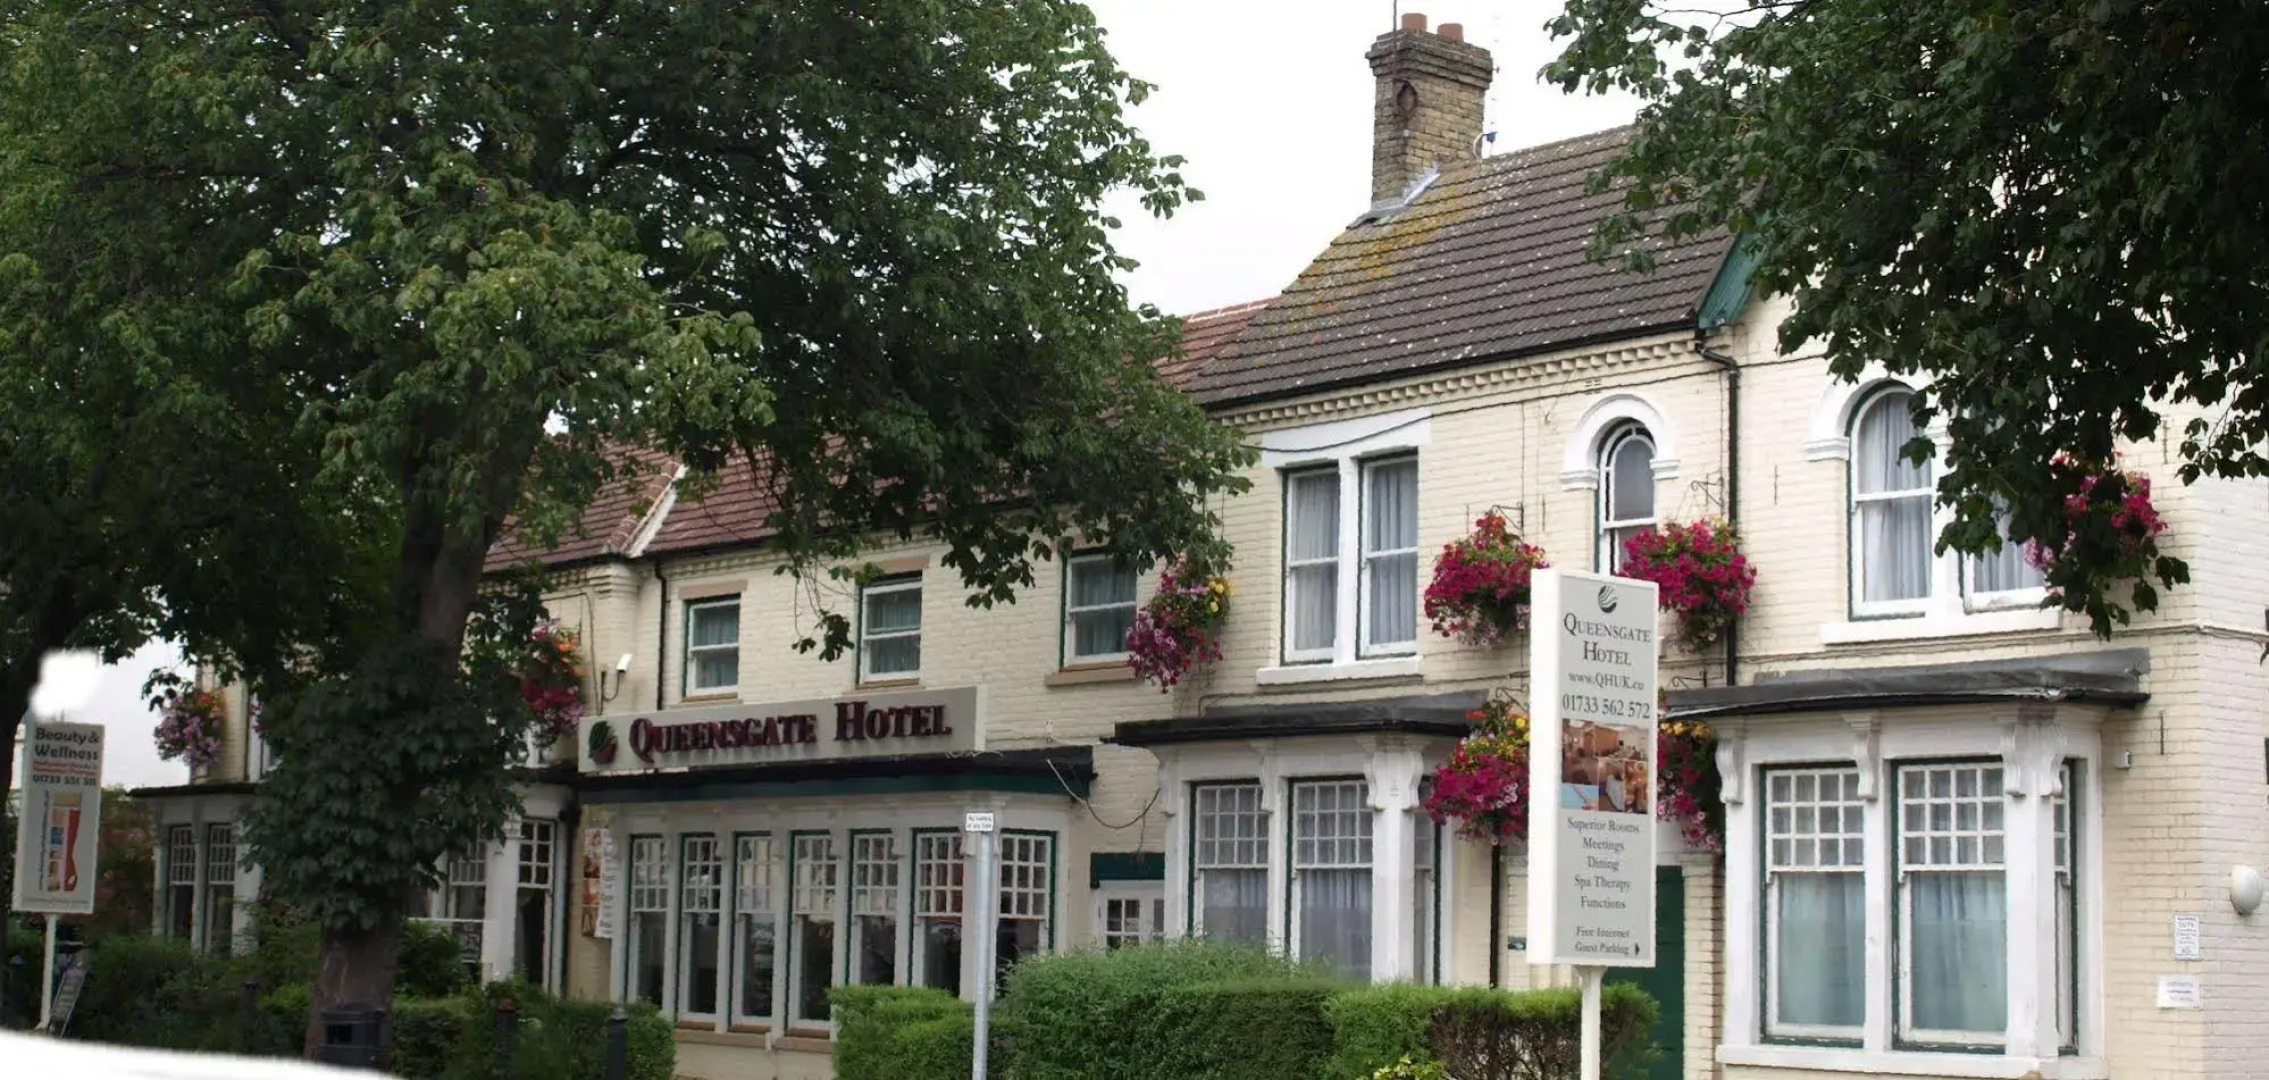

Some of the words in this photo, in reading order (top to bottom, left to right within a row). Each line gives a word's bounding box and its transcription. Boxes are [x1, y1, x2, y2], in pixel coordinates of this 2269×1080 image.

[1564, 612, 1651, 643] QUEENSGATE
[1582, 641, 1632, 666] HOTEL
[1562, 693, 1598, 713] 01733
[1601, 698, 1624, 716] 562
[1627, 701, 1650, 719] 572
[35, 727, 87, 745] Beauty
[88, 730, 99, 743] &
[629, 713, 818, 764] QUEENSGATE
[833, 700, 953, 742] HOTEL
[35, 744, 98, 760] Wellness
[1567, 817, 1606, 832] Superior
[1609, 820, 1640, 833] Rooms
[1583, 837, 1625, 854] Meetings
[1588, 855, 1620, 872] Dining
[1575, 875, 1592, 891] Spa
[1595, 876, 1631, 893] Therapy
[1581, 896, 1626, 909] Functions
[1576, 926, 1595, 938] Free
[1598, 927, 1630, 938] Internet
[1575, 941, 1598, 953] Guest
[1600, 942, 1629, 955] Parking
